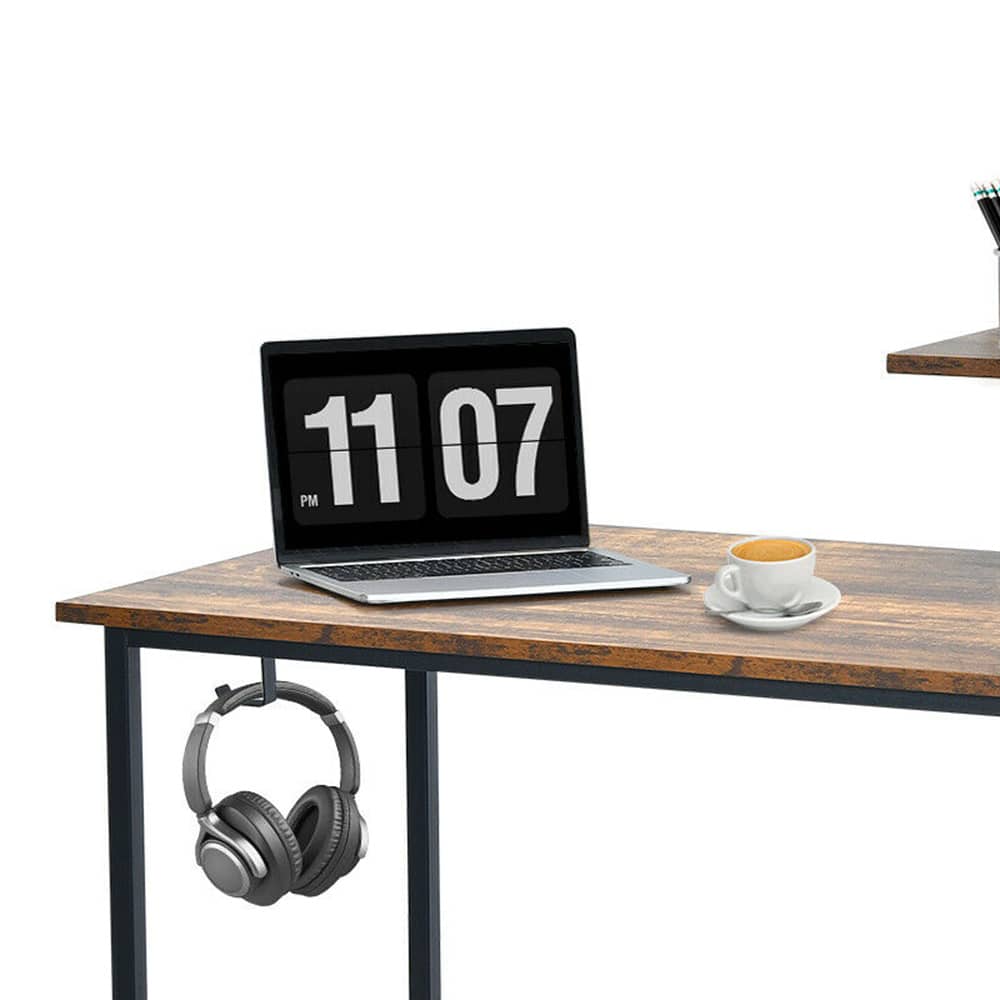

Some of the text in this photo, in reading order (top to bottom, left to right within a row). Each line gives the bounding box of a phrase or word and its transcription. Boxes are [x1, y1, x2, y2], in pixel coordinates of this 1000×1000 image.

[304, 385, 554, 506] 11 07
[300, 494, 319, 508] PM
